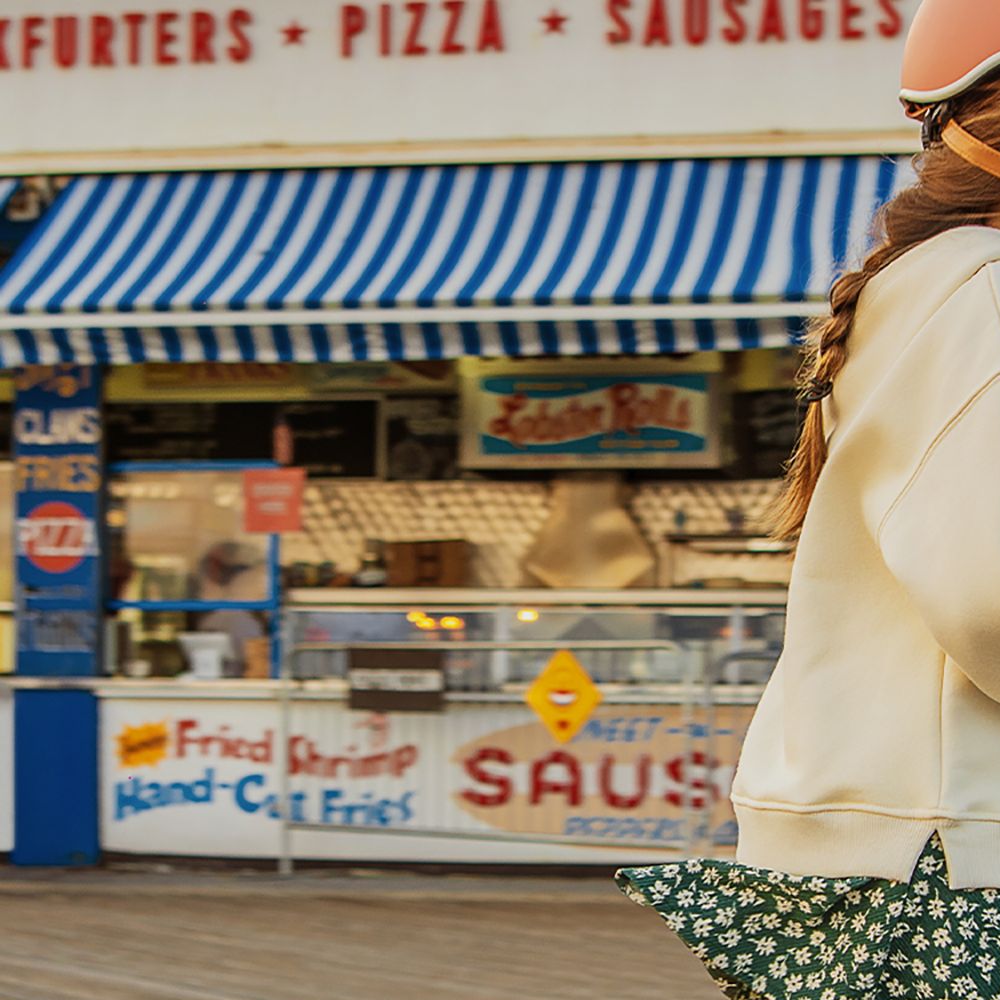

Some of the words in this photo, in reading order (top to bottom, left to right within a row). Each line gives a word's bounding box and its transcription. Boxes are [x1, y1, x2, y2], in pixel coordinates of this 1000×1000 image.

[339, 0, 506, 57] PIZZA
[604, 0, 904, 46] SAUSAGES
[175, 720, 274, 764] Fried
[287, 736, 418, 778] Shrimp
[321, 789, 416, 825] Fries
[458, 747, 721, 811] SAUS
